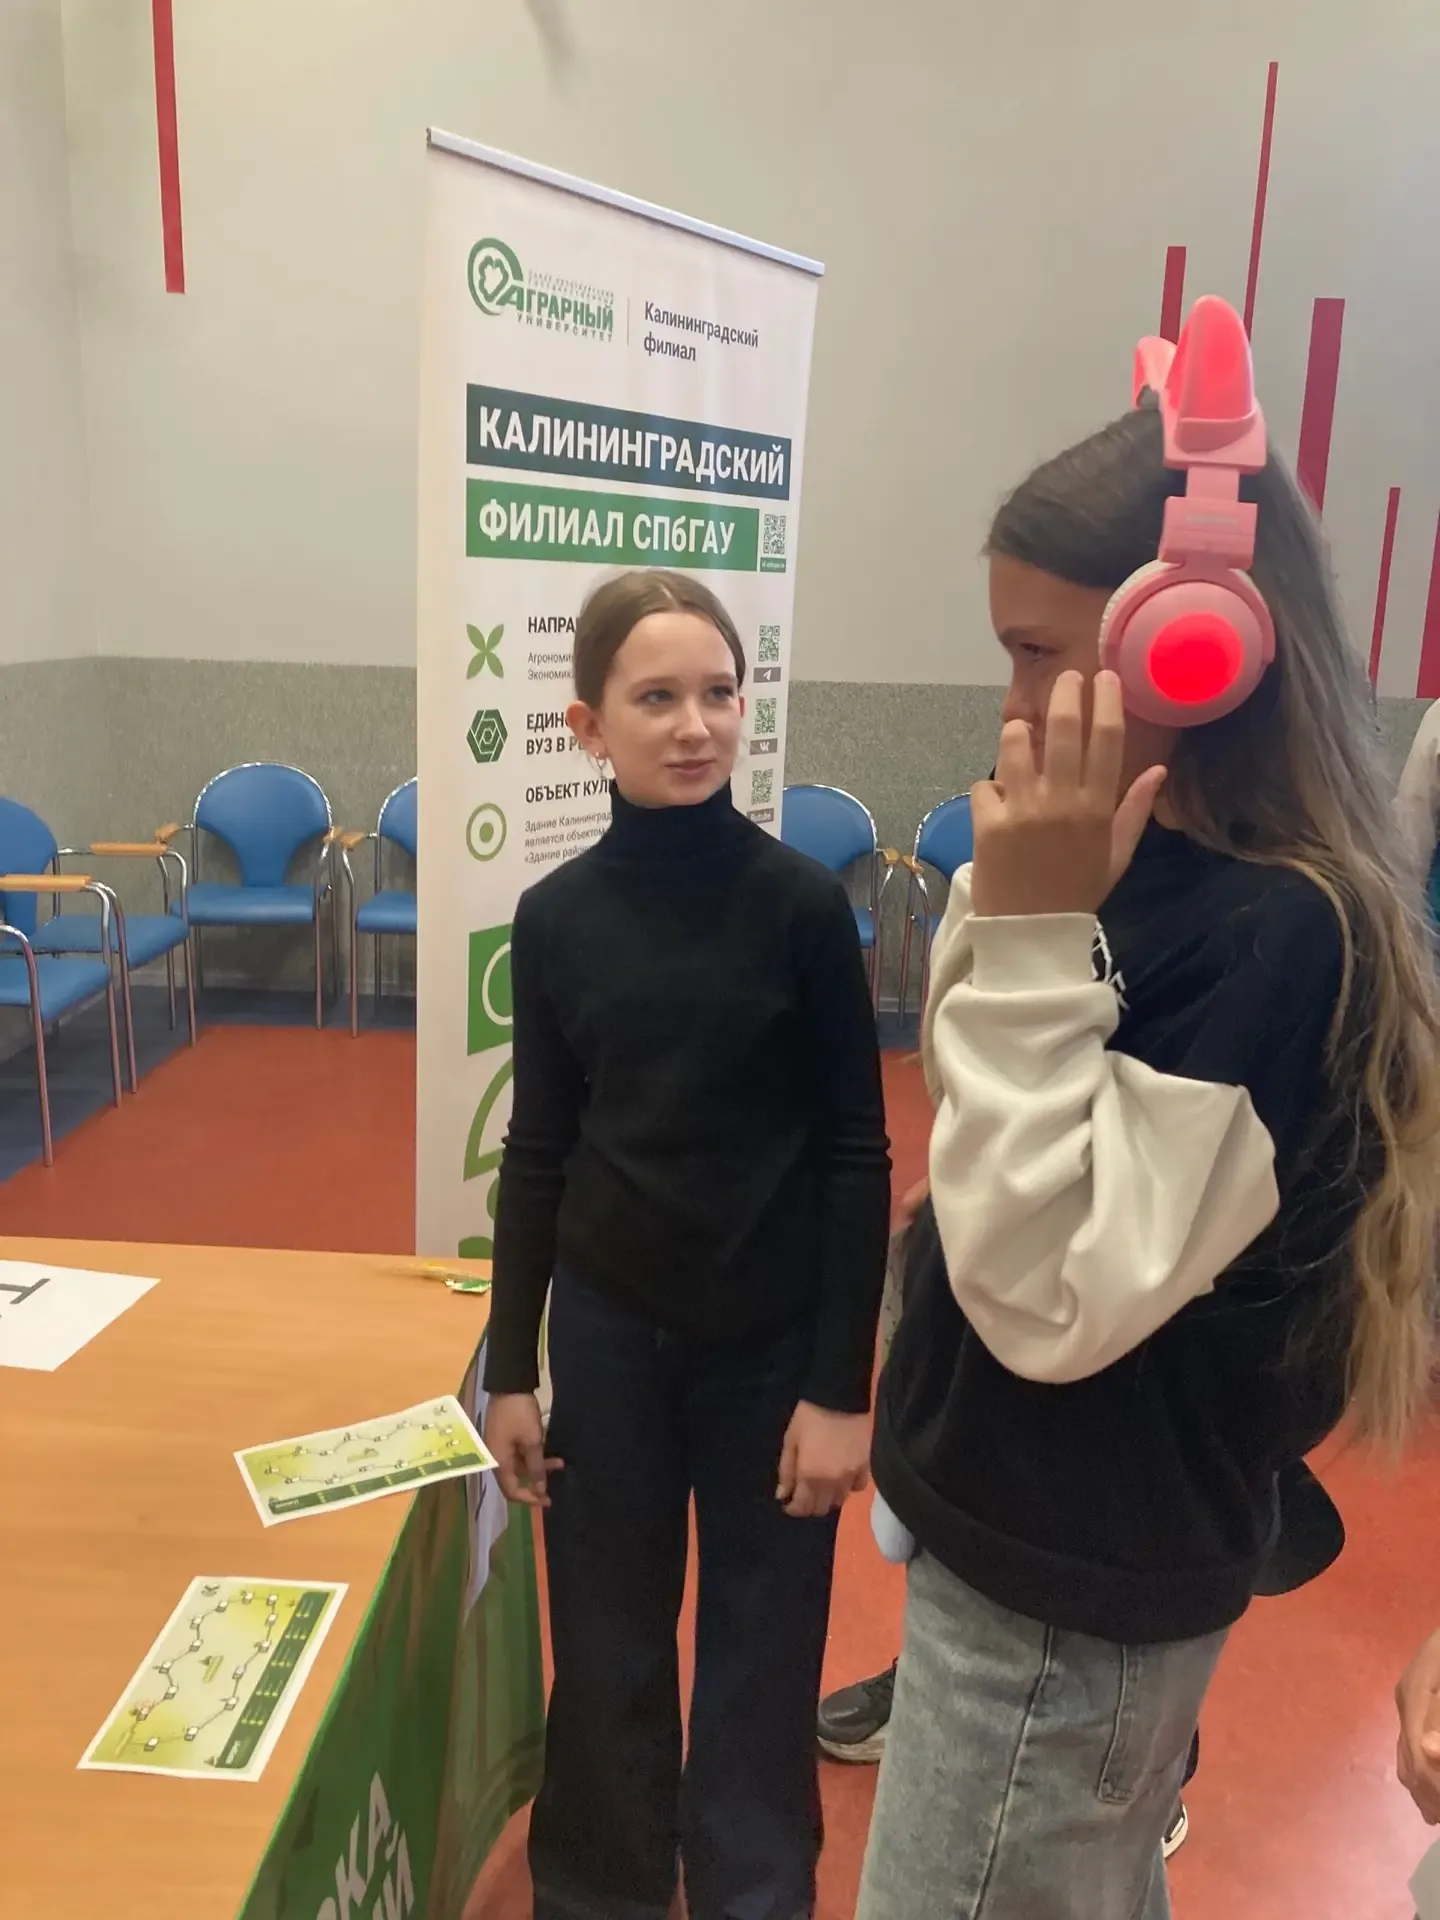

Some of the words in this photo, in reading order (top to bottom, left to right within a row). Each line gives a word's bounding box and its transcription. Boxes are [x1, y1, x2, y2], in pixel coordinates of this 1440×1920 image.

[496, 283, 613, 333] АГРАРНЫЙ
[517, 312, 613, 342] УНИВЕРСИТЕТ
[644, 301, 759, 348] Калининградский
[643, 332, 696, 361] филиал
[479, 405, 785, 486] КАЛИНИНГРАДСКИЙ
[479, 498, 624, 549] ФИЛИАЛ
[632, 513, 735, 555] СПбГАУ
[528, 616, 579, 633] НАПРА
[528, 652, 573, 666] Агрономи
[527, 711, 568, 734] ЕДИН
[526, 737, 552, 755] ВУЗ
[556, 736, 566, 753] В
[525, 782, 581, 803] ОБЪЕКТ
[583, 778, 609, 797] КУЛ
[525, 819, 557, 832] Здание
[559, 811, 612, 827] Калининград
